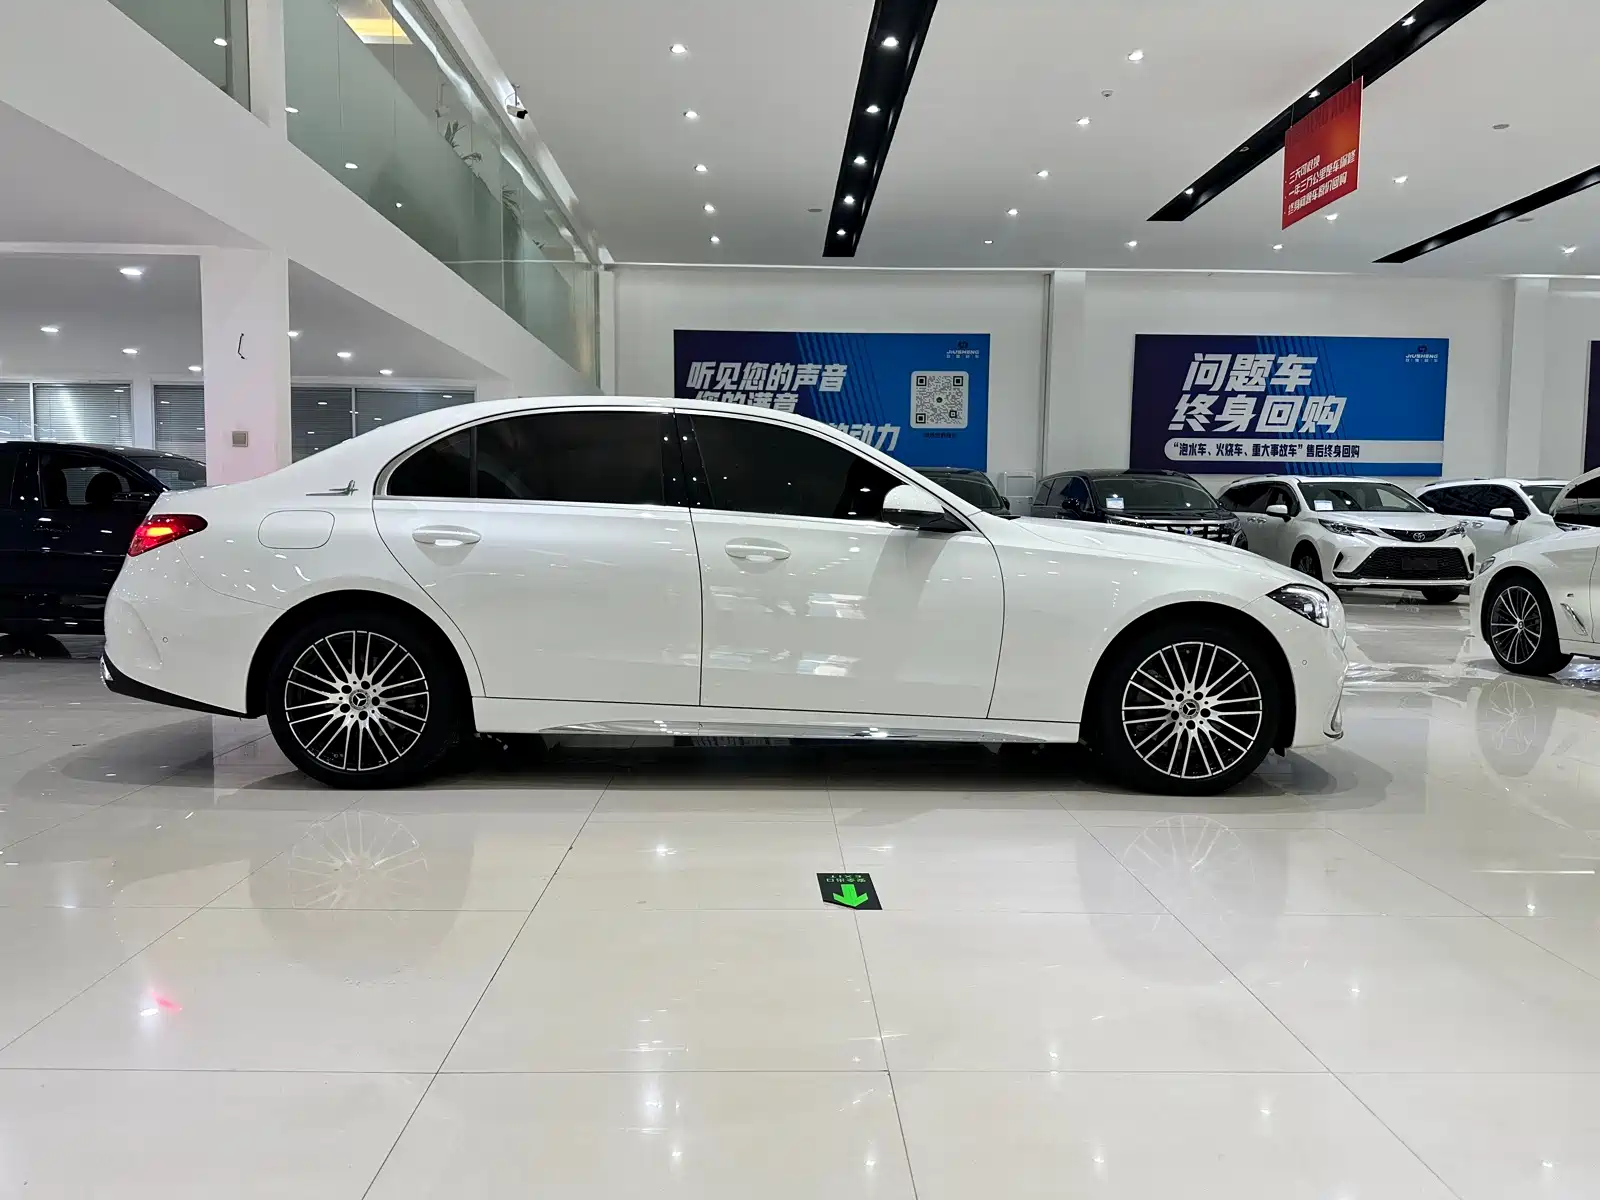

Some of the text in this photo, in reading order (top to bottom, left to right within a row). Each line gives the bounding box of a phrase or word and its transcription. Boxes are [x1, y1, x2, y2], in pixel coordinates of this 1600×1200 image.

[686, 362, 848, 392] 听见您的声音
[1182, 353, 1318, 392] 问题车
[1168, 394, 1347, 433] 终身回购
